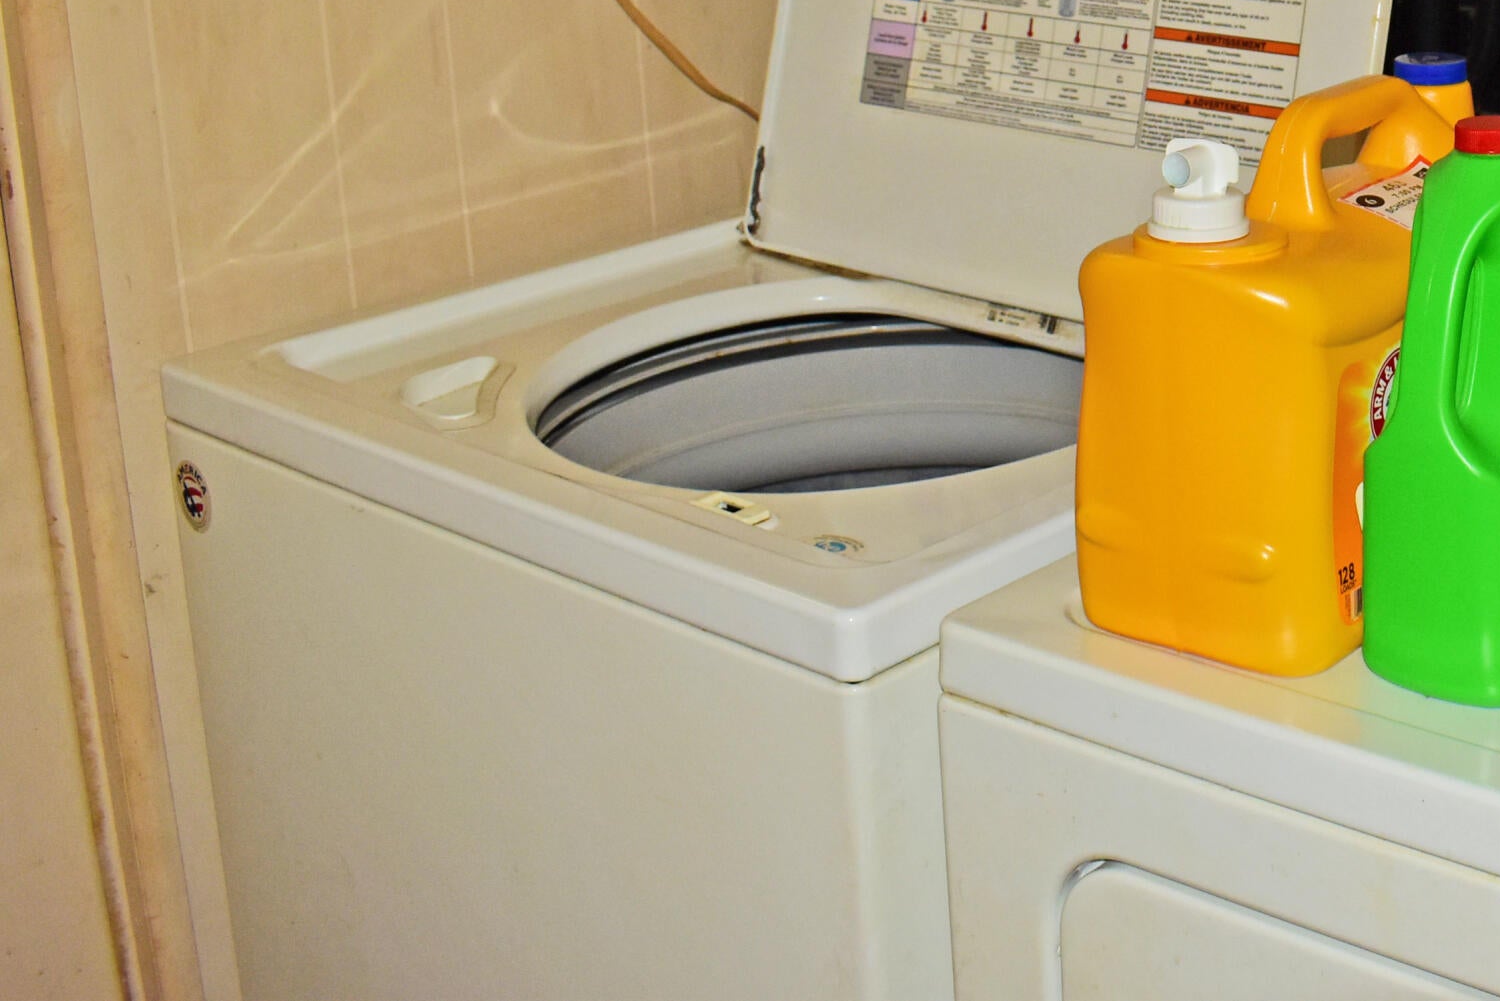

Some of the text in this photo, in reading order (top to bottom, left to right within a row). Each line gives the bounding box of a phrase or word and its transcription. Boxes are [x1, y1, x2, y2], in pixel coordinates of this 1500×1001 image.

[1195, 33, 1267, 50] AVERTISSEMENT
[1192, 97, 1250, 113] ADVERTENCIA
[1373, 365, 1394, 420] ARM &
[1338, 562, 1355, 586] 128
